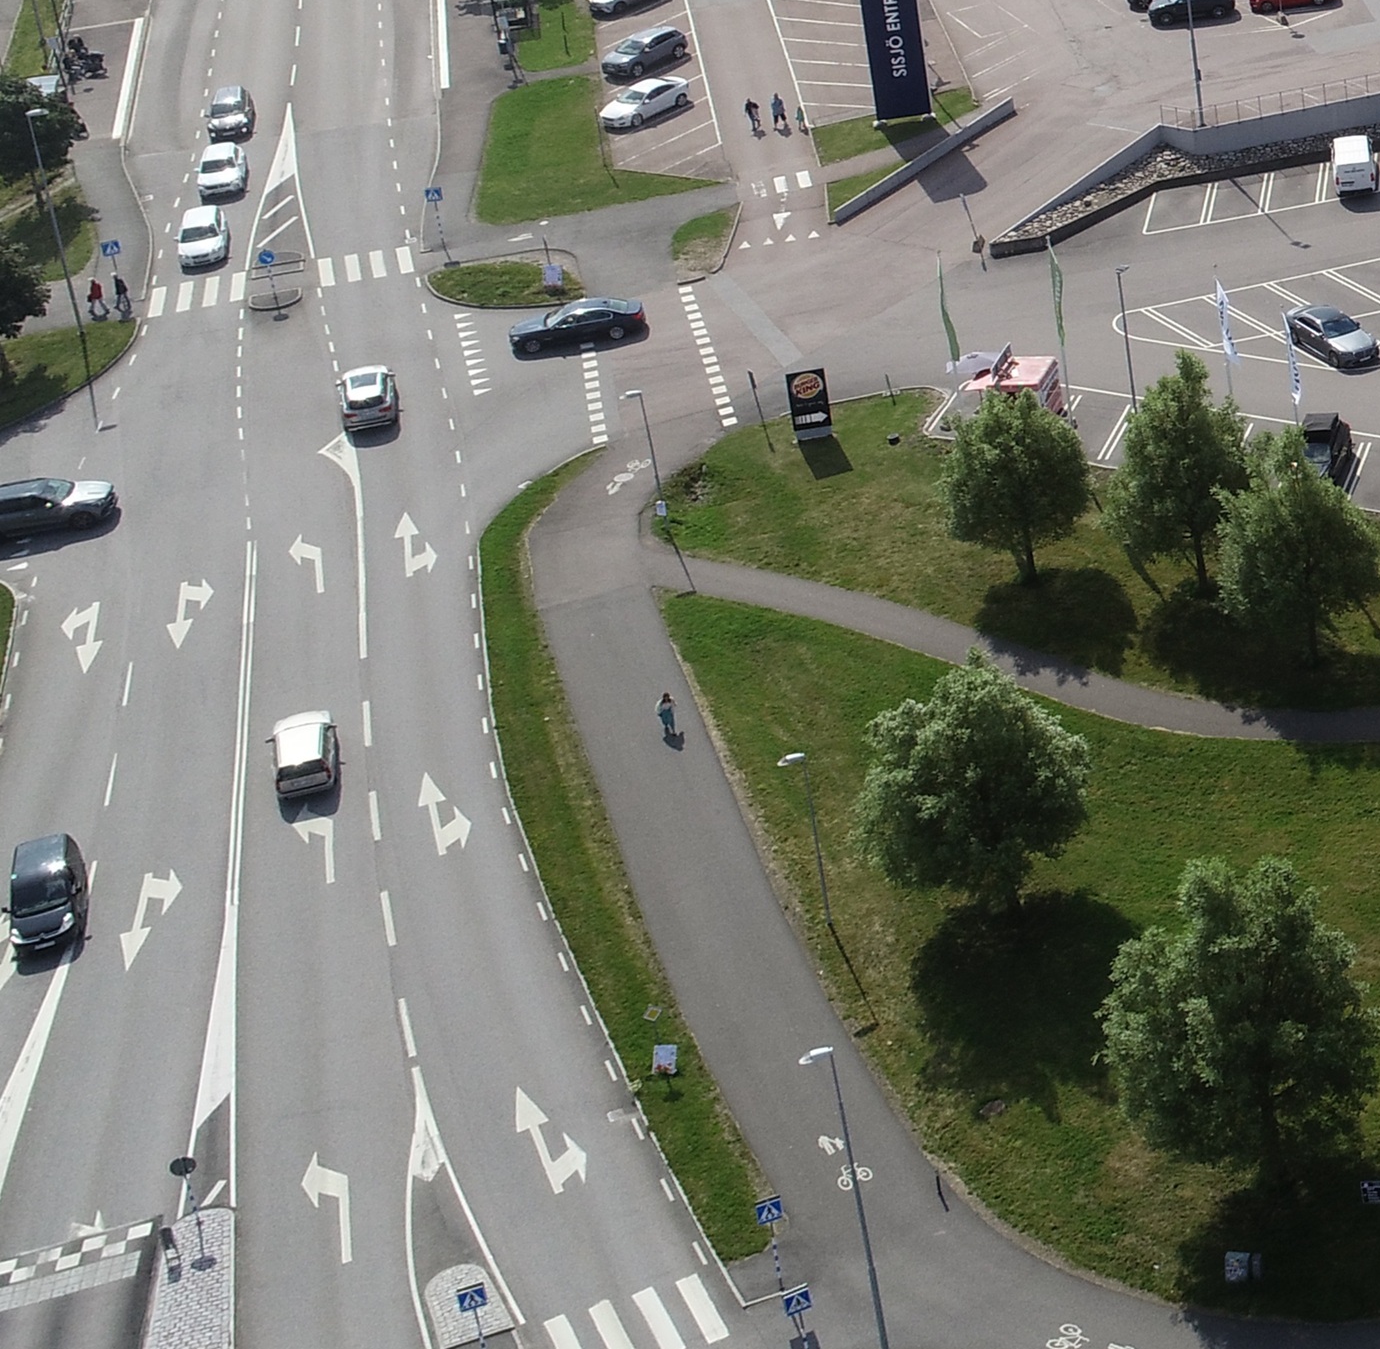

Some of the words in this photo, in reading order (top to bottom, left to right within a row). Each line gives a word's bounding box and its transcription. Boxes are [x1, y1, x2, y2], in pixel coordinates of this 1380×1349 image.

[886, 35, 908, 78] SISJÖ
[794, 377, 819, 389] BURGER
[795, 382, 821, 397] KING
